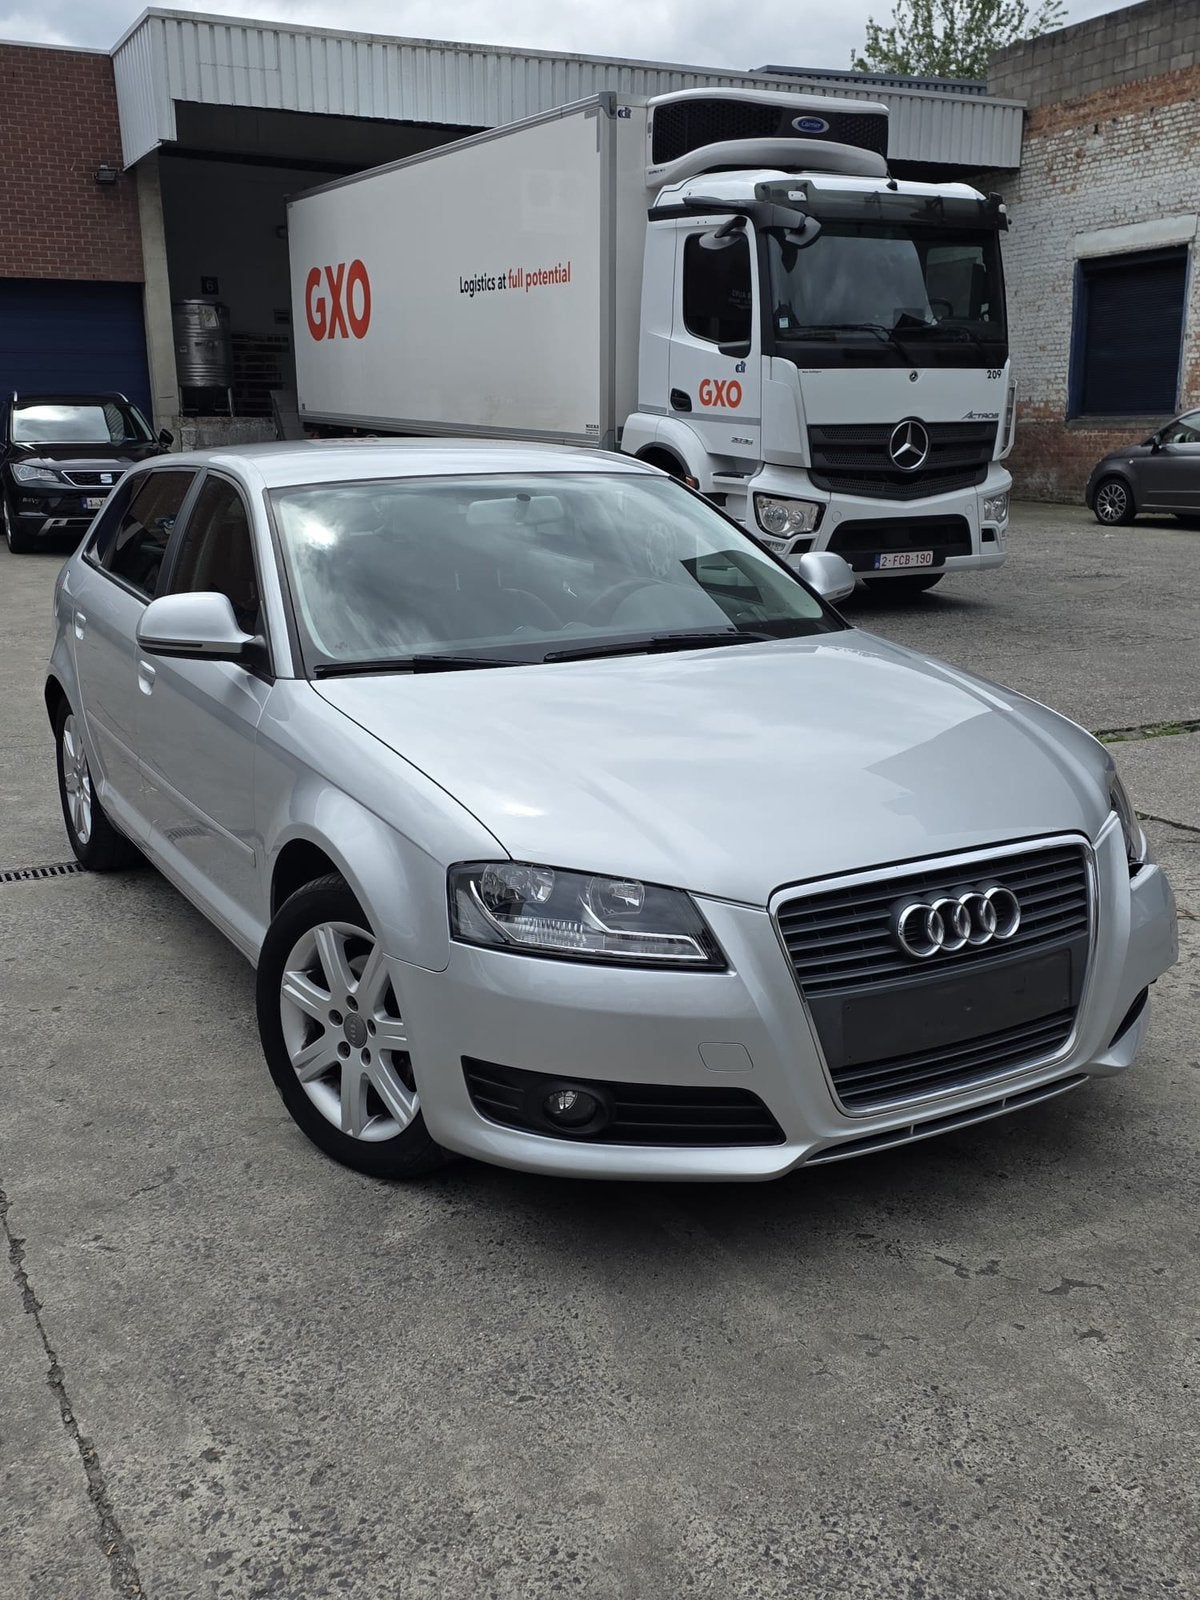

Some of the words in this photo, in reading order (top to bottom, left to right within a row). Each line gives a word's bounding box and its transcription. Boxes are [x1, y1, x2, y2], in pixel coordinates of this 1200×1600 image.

[459, 274, 496, 298] Logistics
[497, 273, 507, 290] at
[508, 268, 523, 289] full
[525, 261, 571, 292] potential
[305, 259, 371, 341] GXO
[986, 369, 1002, 379] 209
[699, 378, 743, 408] GXO
[881, 553, 932, 567] 2-FCB-190
